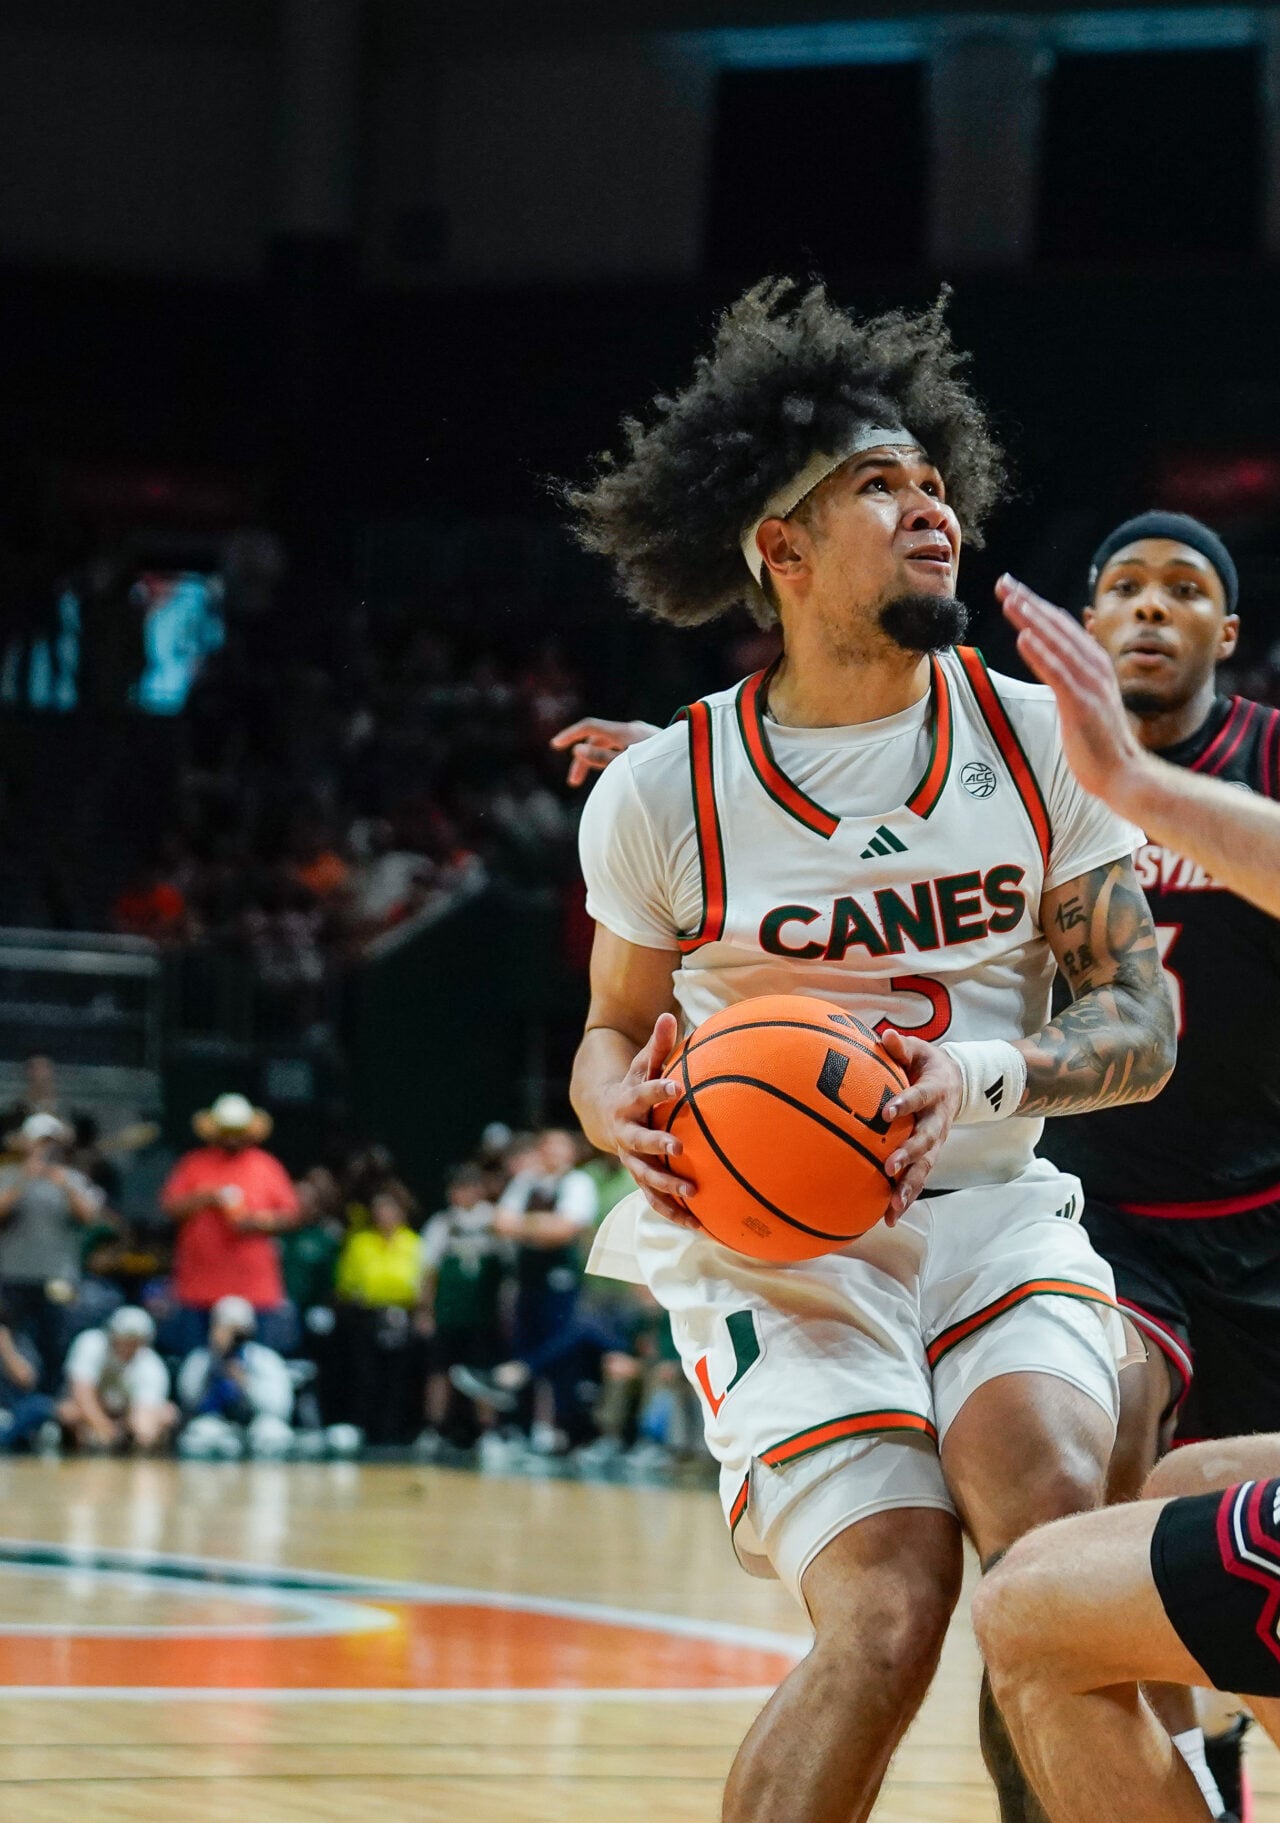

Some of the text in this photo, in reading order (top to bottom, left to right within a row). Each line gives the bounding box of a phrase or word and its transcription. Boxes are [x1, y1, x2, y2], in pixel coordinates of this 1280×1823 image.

[965, 771, 993, 783] ACC
[758, 863, 1026, 961] CANES
[694, 1309, 761, 1419] U
